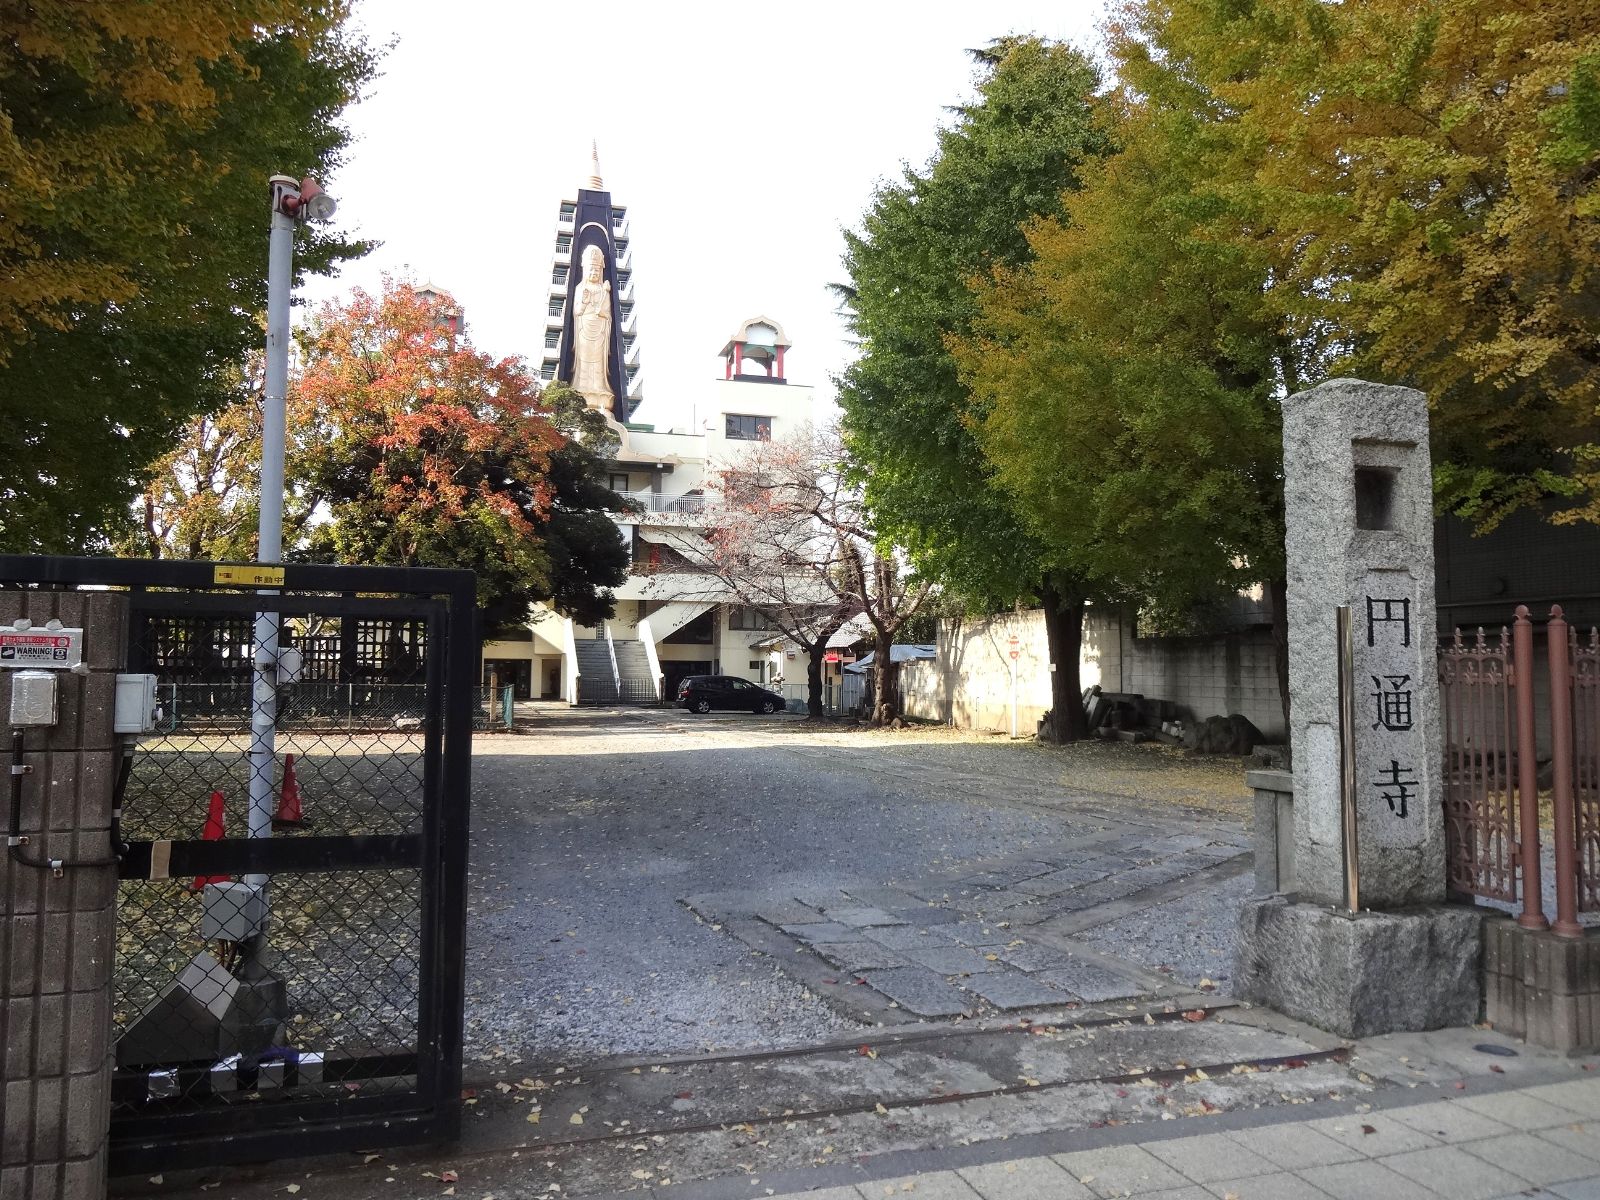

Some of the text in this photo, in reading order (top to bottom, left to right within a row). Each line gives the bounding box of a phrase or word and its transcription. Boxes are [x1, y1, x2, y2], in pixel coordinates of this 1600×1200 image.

[254, 575, 284, 584] 作動中
[16, 647, 53, 655] WARNING!
[1366, 595, 1420, 819] 円通寺
